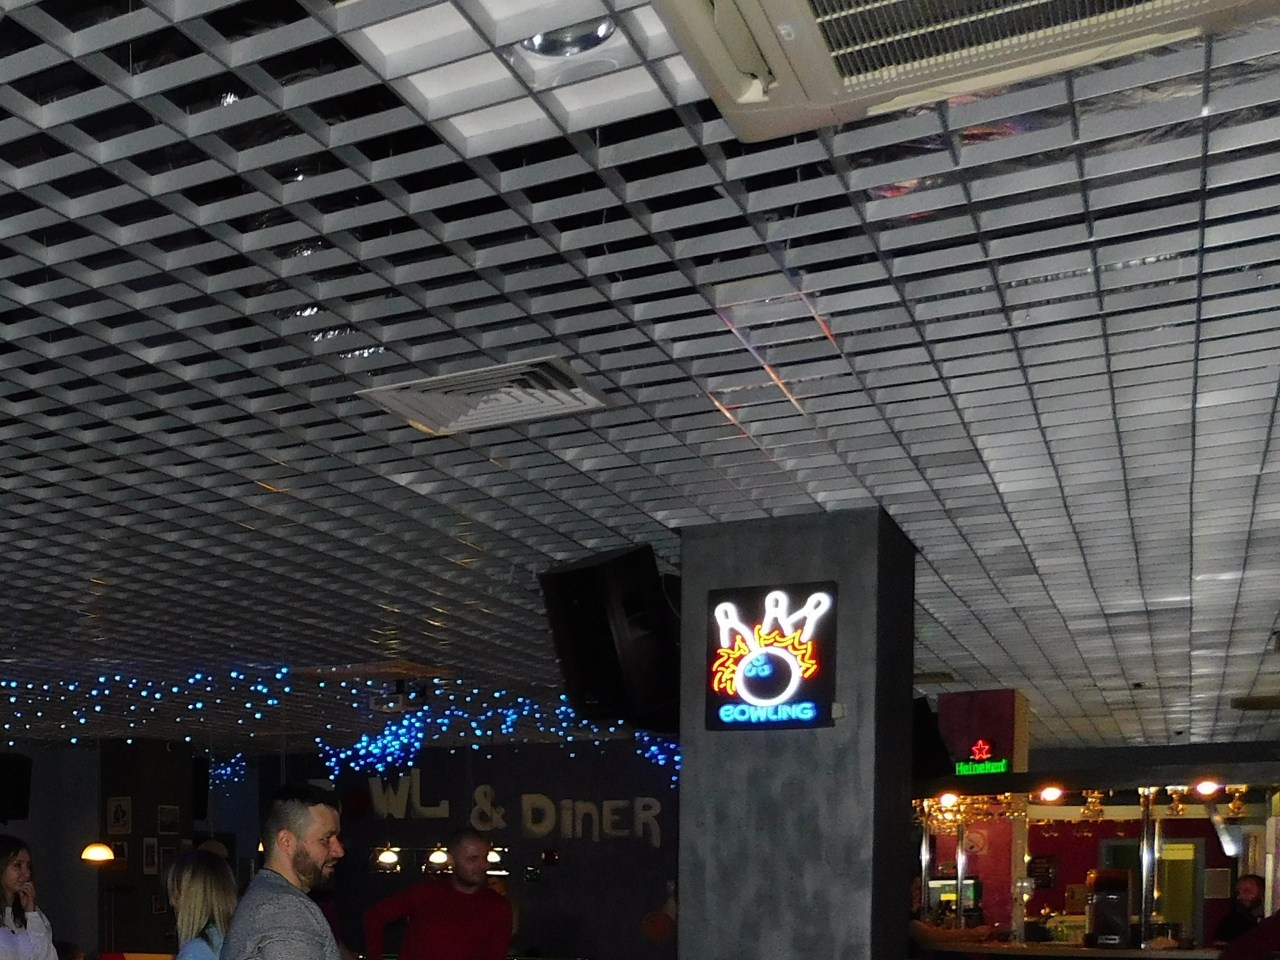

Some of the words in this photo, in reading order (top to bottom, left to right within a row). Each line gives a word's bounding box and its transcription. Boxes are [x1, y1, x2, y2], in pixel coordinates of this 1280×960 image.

[719, 701, 816, 723] BOWLING
[955, 759, 1008, 776] Heineken
[471, 784, 507, 831] &
